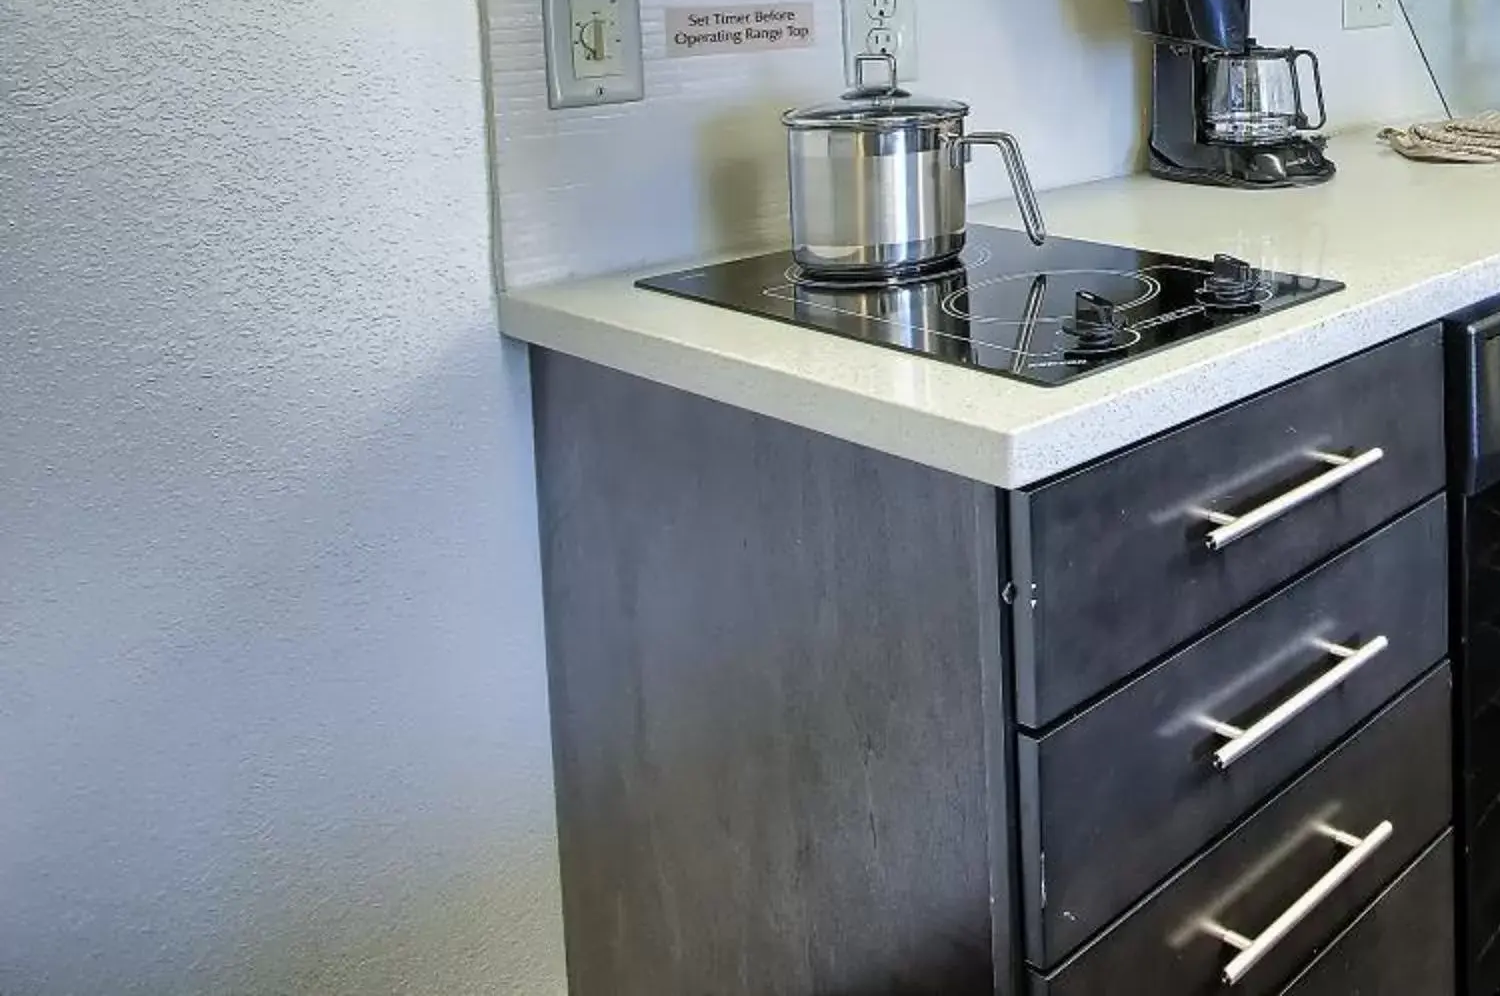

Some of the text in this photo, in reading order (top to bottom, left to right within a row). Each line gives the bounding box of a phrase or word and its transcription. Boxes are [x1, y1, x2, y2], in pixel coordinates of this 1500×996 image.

[688, 10, 796, 26] Set Timer Before
[674, 25, 809, 48] Operating Range Top
